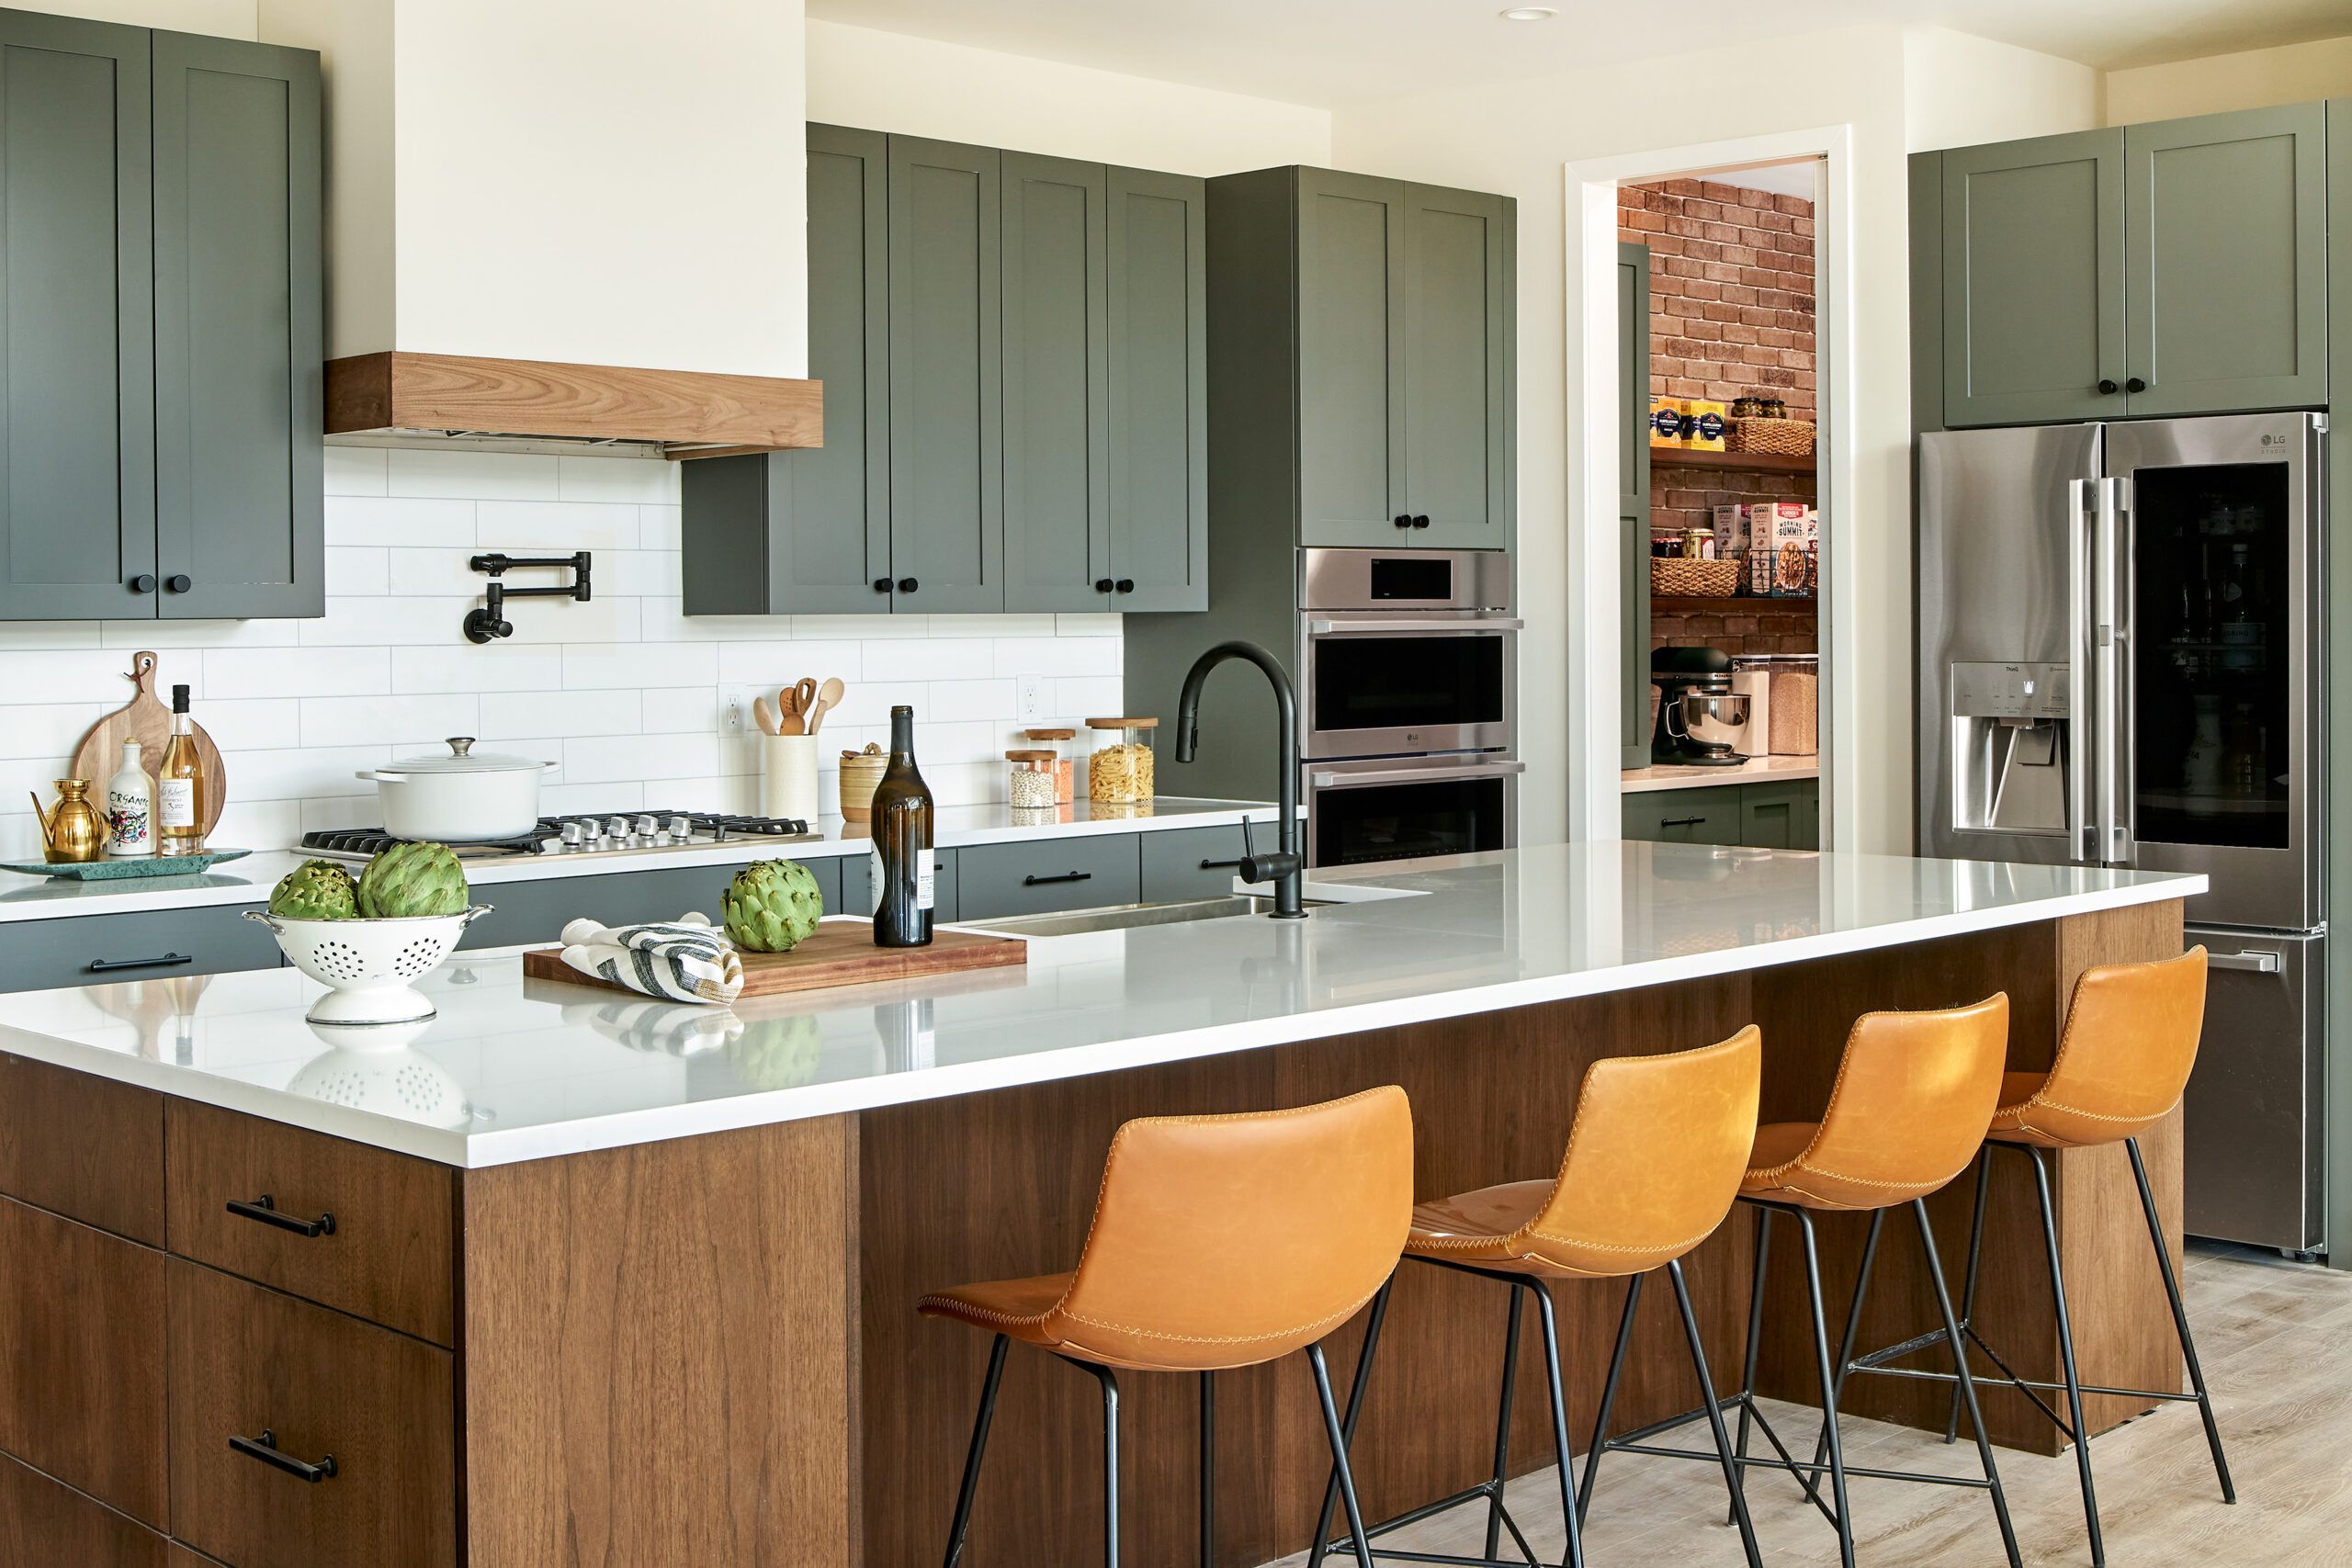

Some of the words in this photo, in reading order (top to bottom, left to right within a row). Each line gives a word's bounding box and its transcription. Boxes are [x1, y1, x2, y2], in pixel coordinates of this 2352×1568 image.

[2273, 435, 2286, 444] LG
[1779, 520, 1802, 529] MORNING
[1779, 527, 1803, 536] SUMMIT
[109, 791, 149, 807] ORGANIC
